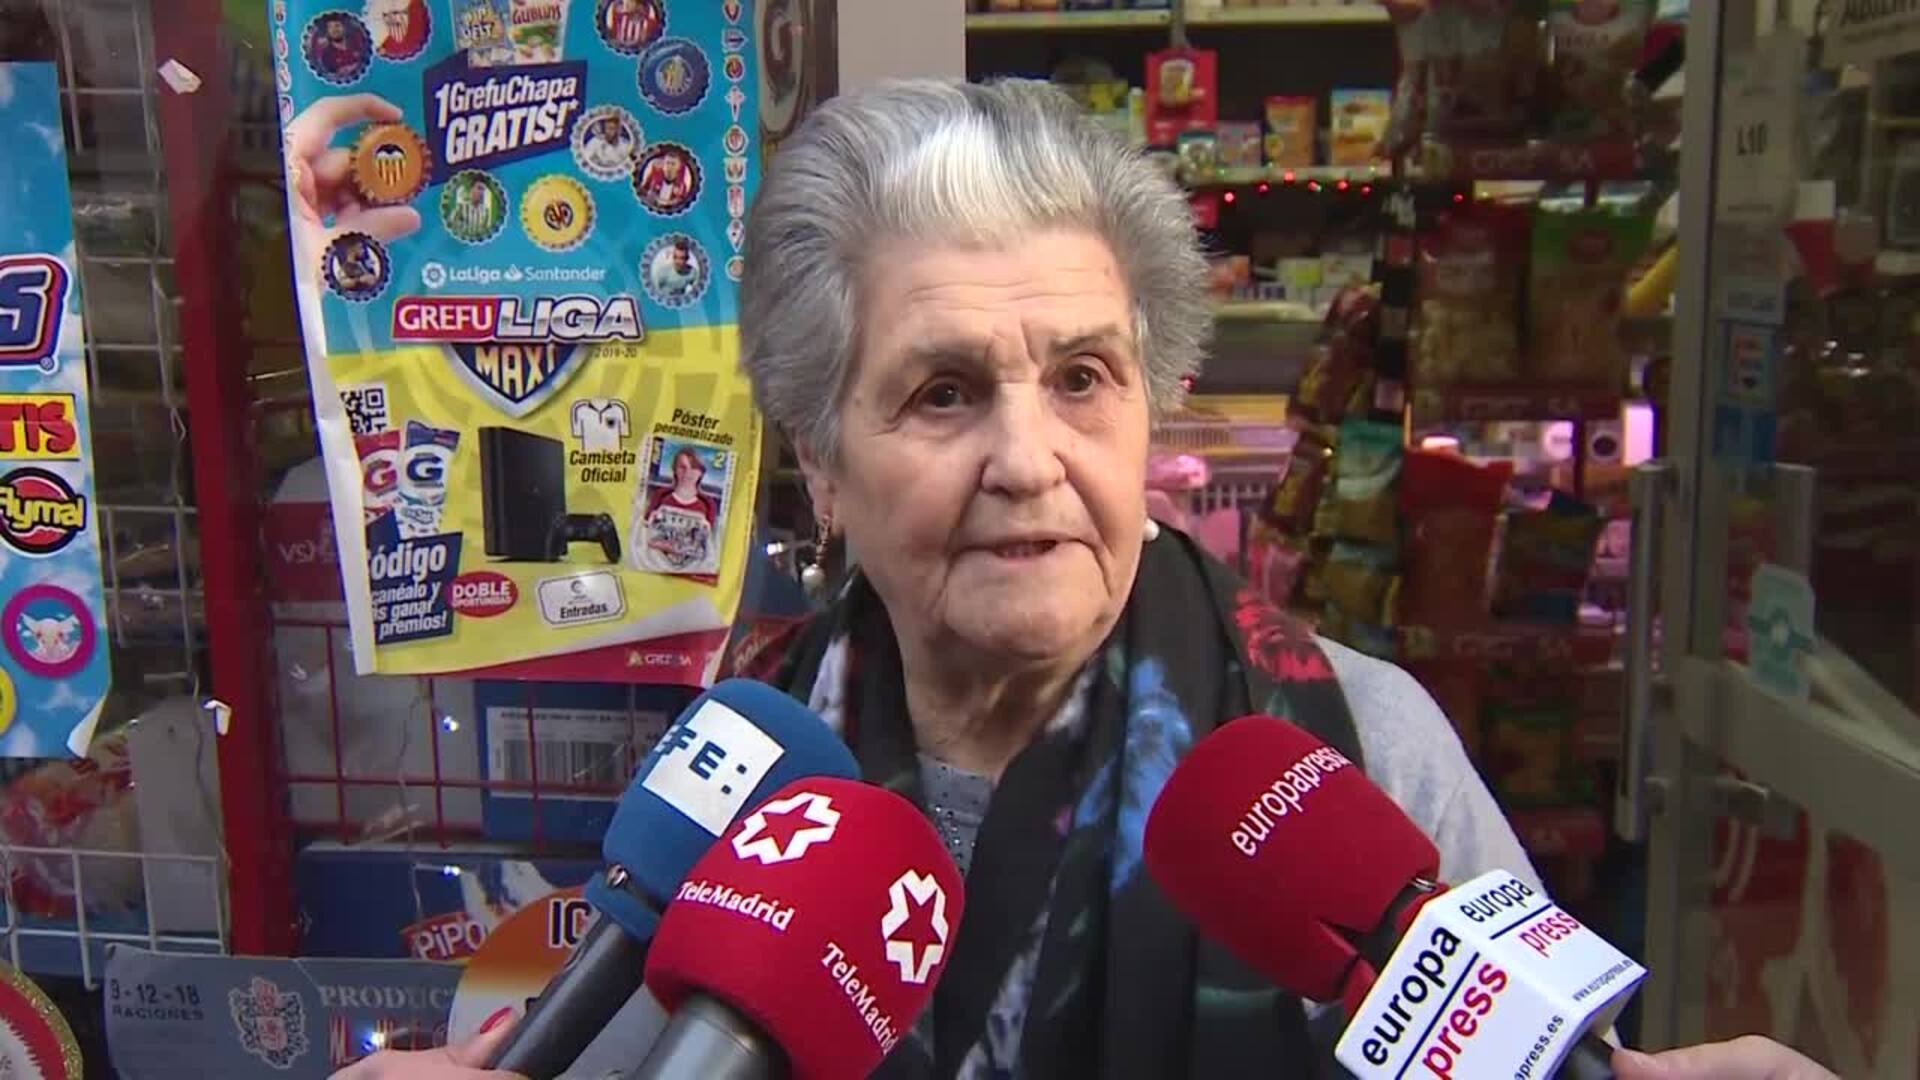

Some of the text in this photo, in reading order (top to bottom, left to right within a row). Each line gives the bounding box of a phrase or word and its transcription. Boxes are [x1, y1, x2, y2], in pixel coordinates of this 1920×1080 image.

[450, 266, 606, 281] LaLiga Santander
[671, 407, 721, 430] Póster
[653, 422, 734, 445] personalizado
[569, 450, 636, 465] Camiseta
[581, 467, 627, 482] Oficial
[452, 581, 511, 599] DOBLE
[391, 599, 433, 622] ganar
[560, 603, 608, 619] Entradas
[378, 611, 447, 640] premios!
[676, 880, 795, 932] TeleMadrid
[1459, 878, 1535, 923] europa
[1519, 911, 1580, 958] press
[319, 984, 452, 1010] PRODUC
[821, 941, 900, 1056] TeleMadrid
[1361, 926, 1462, 1066] europa
[1422, 962, 1509, 1080] press
